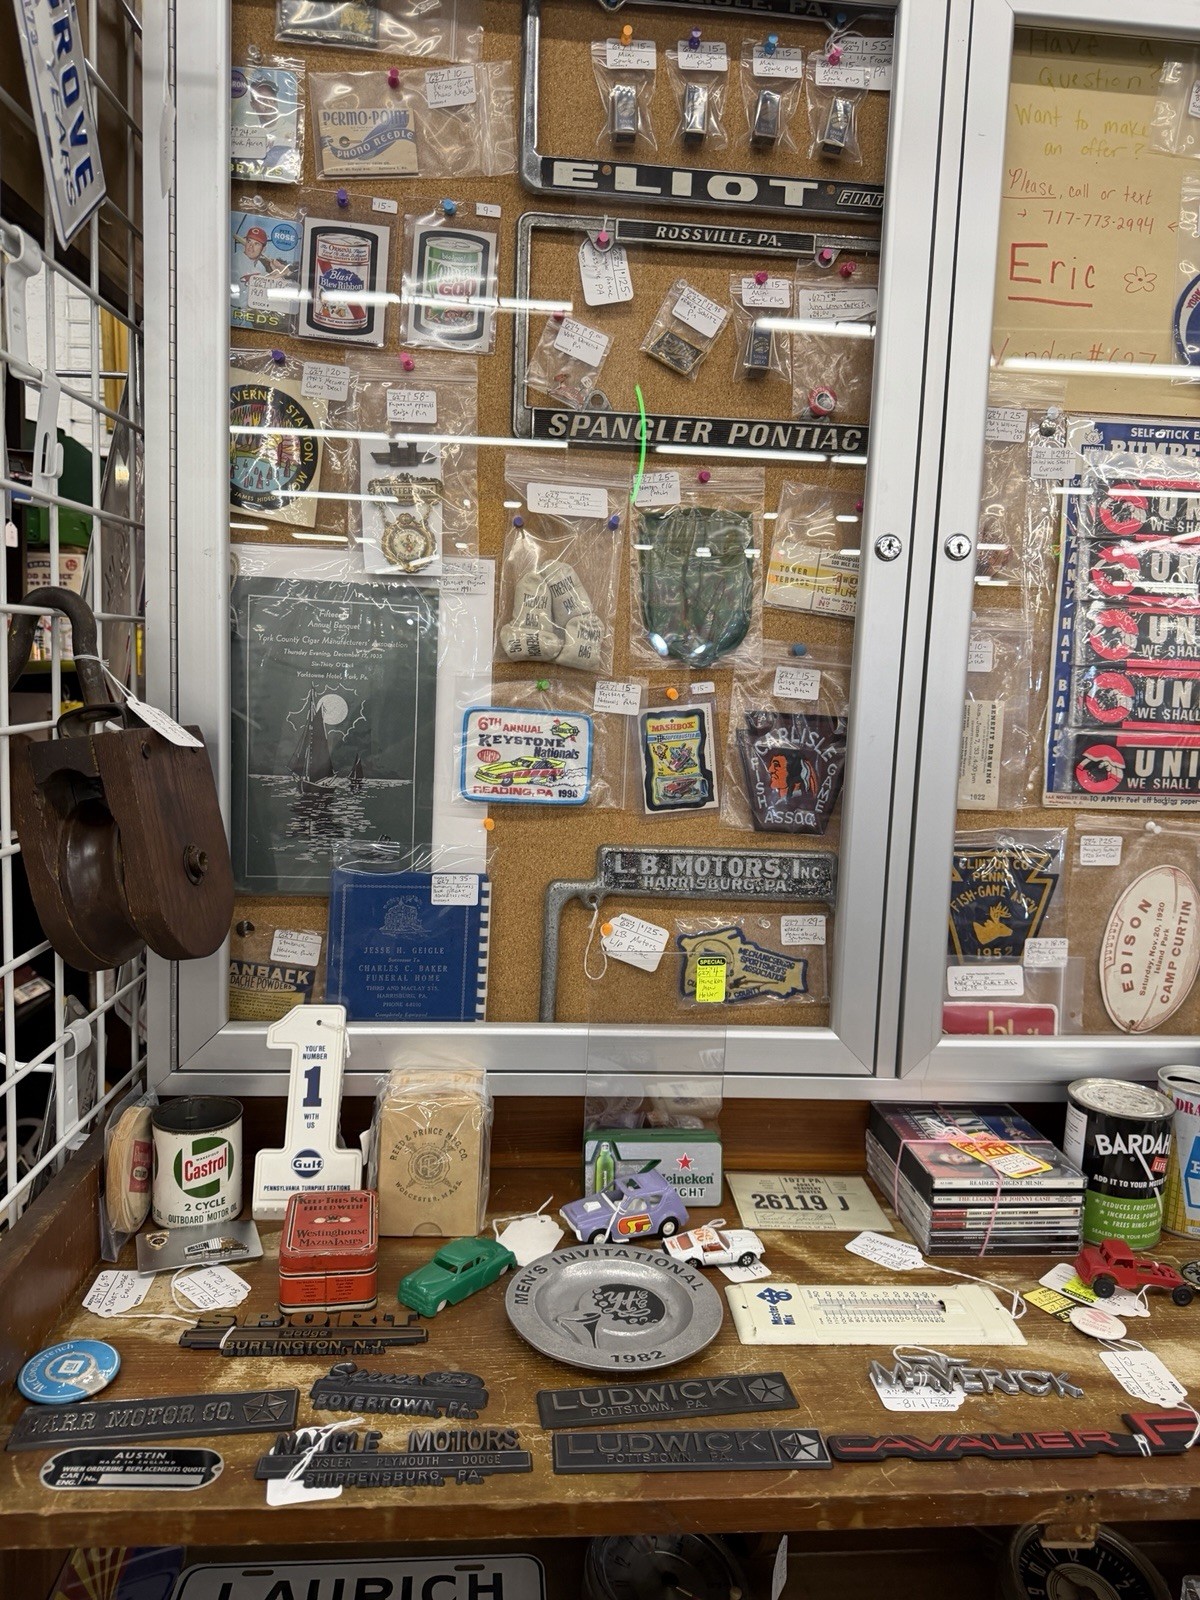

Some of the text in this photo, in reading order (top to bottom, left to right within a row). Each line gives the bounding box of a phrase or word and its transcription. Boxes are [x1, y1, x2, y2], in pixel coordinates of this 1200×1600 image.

[1029, 30, 1154, 57] Have a
[48, 0, 95, 198] ROVE
[1014, 103, 1149, 138] Want to make
[336, 128, 415, 158] PHONO NEEDLE
[1043, 143, 1062, 157] an
[552, 160, 819, 207] ELIOT
[839, 192, 884, 207] FIAT
[1068, 183, 1089, 198] call
[1100, 189, 1117, 201] or
[1123, 186, 1153, 205] text
[273, 233, 296, 242] ROSE
[757, 233, 783, 247] PA.
[1009, 242, 1096, 290] Eric
[329, 269, 353, 281] Blast
[321, 278, 363, 291] Blew Ribbon
[232, 310, 280, 325] REDS
[548, 412, 862, 451] SPANGLER PONTIAC
[308, 620, 361, 631] Annual Banquet
[275, 635, 300, 644] County
[302, 636, 320, 646] Cigar
[1060, 617, 1072, 663] HAT
[1142, 645, 1163, 657] WE
[1137, 708, 1158, 720] WE
[477, 716, 544, 735] 6TH ANNUAL
[650, 720, 696, 732] MASHBOX
[477, 734, 566, 748] KEYSTONE
[755, 726, 838, 763] CARLISLE
[533, 746, 580, 760] Nationals
[750, 757, 768, 809] FISH
[814, 763, 837, 814] GAME
[1127, 778, 1191, 789] WE SHALL
[765, 880, 793, 892] PA.
[412, 947, 445, 955] GEIGLE
[1121, 898, 1153, 994] EDISON
[1139, 902, 1166, 996] Saturday, 1920
[1154, 928, 1170, 975] Island Park
[1160, 901, 1193, 1004] CAMP CURTIN
[419, 965, 448, 973] BAKER
[699, 958, 725, 966] SPECIAL
[256, 978, 292, 990] POWDERS
[414, 974, 441, 982] HOME
[302, 1066, 323, 1107] 1
[306, 1121, 316, 1129] US
[389, 1127, 469, 1162] REED PRINCE CO.
[184, 1147, 227, 1182] Castrol
[293, 1159, 323, 1170] Gulf
[662, 1173, 714, 1185] eineken
[1093, 1174, 1148, 1189] ADD IT TO YOUR
[184, 1196, 226, 1212] 2 CYCLE
[751, 1193, 850, 1211] 26119 J
[1102, 1200, 1131, 1211] REDUCES
[167, 1202, 238, 1225] OUTBOARD MOTOR OIL
[1107, 1210, 1140, 1220] INCREASES
[1112, 1220, 1148, 1229] FREES RINGS
[296, 1228, 368, 1238] Westinghouse
[1091, 1228, 1141, 1240] SEALED FOR YOUR
[514, 1247, 707, 1305] MEN'S INVITATIONAL
[197, 1311, 421, 1329] SPORT
[771, 1304, 780, 1325] Master
[783, 1311, 796, 1326] Mix
[282, 1328, 330, 1338] Dodge
[354, 1340, 386, 1350] N.J.
[610, 1350, 667, 1364] 1982
[869, 1358, 1085, 1398] MAVERICK
[551, 1378, 739, 1411] LUDWICK
[105, 1404, 195, 1428] MOTOR
[202, 1401, 235, 1421] CO.
[590, 1399, 709, 1418] POTTSTOWN, PA.
[408, 1429, 523, 1453] MOTORS
[566, 1431, 768, 1455] LUDWICK
[835, 1430, 1121, 1452] CAVALIER
[115, 1451, 168, 1459] AUSTIN
[376, 1454, 502, 1466] PLYMOUTH DODGE
[606, 1452, 734, 1463] POTTSTOWN, PA.
[458, 1469, 483, 1480] PA.
[216, 1572, 504, 1600] LAURICH
